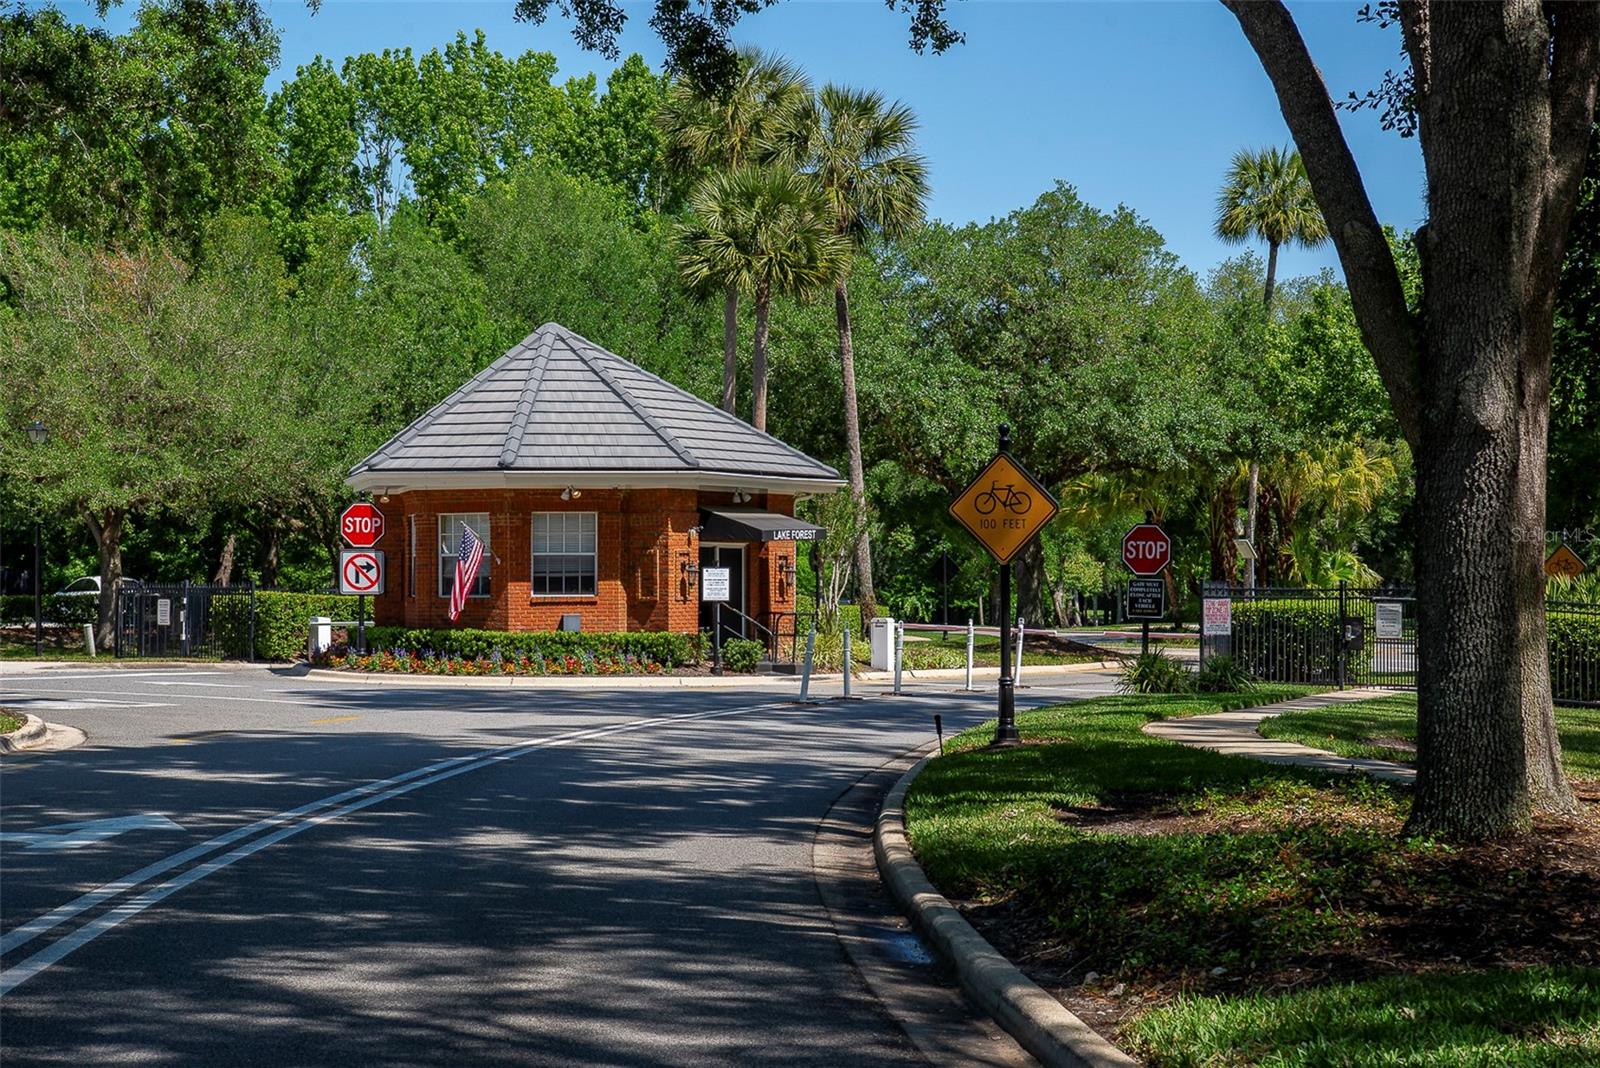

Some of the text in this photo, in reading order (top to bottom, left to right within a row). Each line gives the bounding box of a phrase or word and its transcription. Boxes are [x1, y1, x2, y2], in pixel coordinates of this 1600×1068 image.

[344, 517, 381, 533] STOP
[980, 519, 1027, 529] 100 FEET
[773, 530, 817, 540] LAKE FOREST
[1126, 541, 1167, 559] STOP
